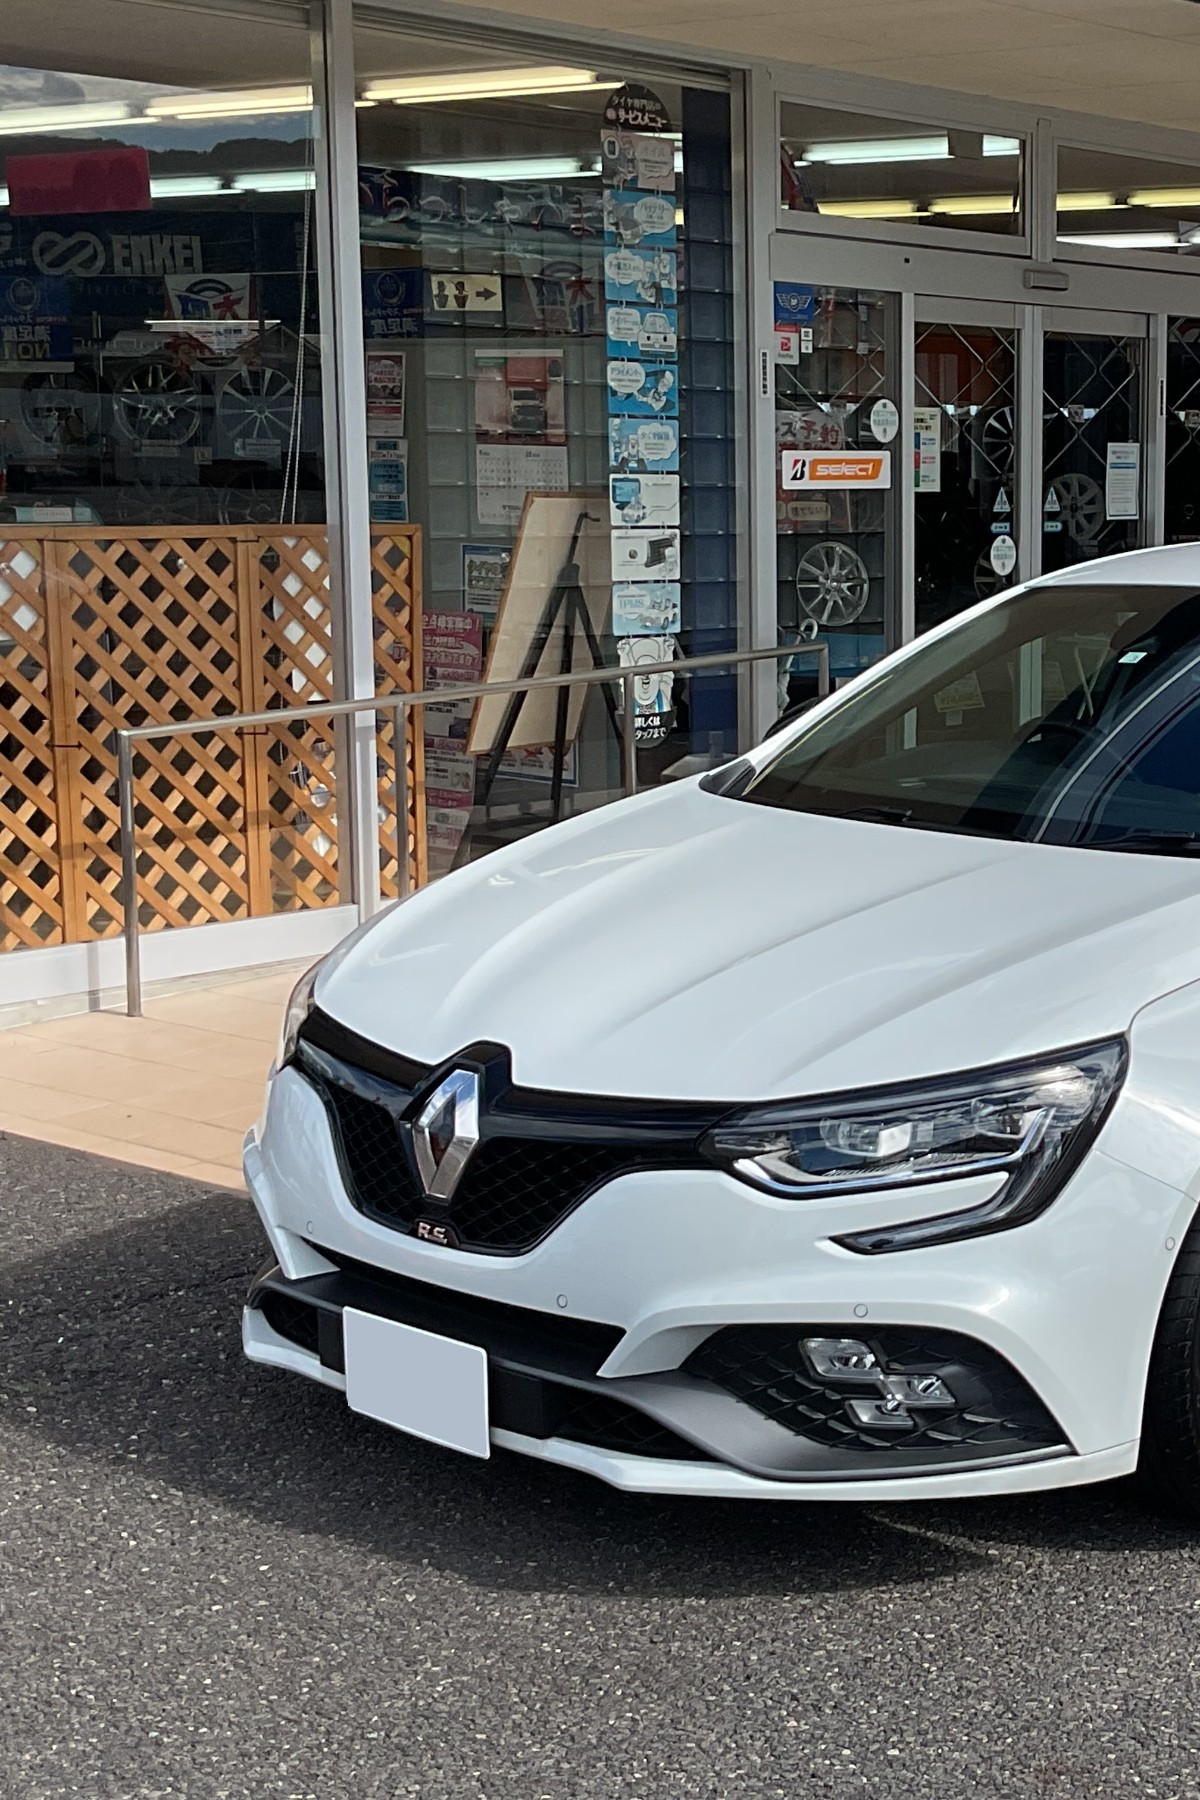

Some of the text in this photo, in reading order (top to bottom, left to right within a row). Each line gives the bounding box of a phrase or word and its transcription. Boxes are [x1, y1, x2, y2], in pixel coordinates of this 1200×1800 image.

[111, 234, 203, 275] ENKEI
[777, 419, 841, 446] ス予約
[816, 462, 874, 476] select
